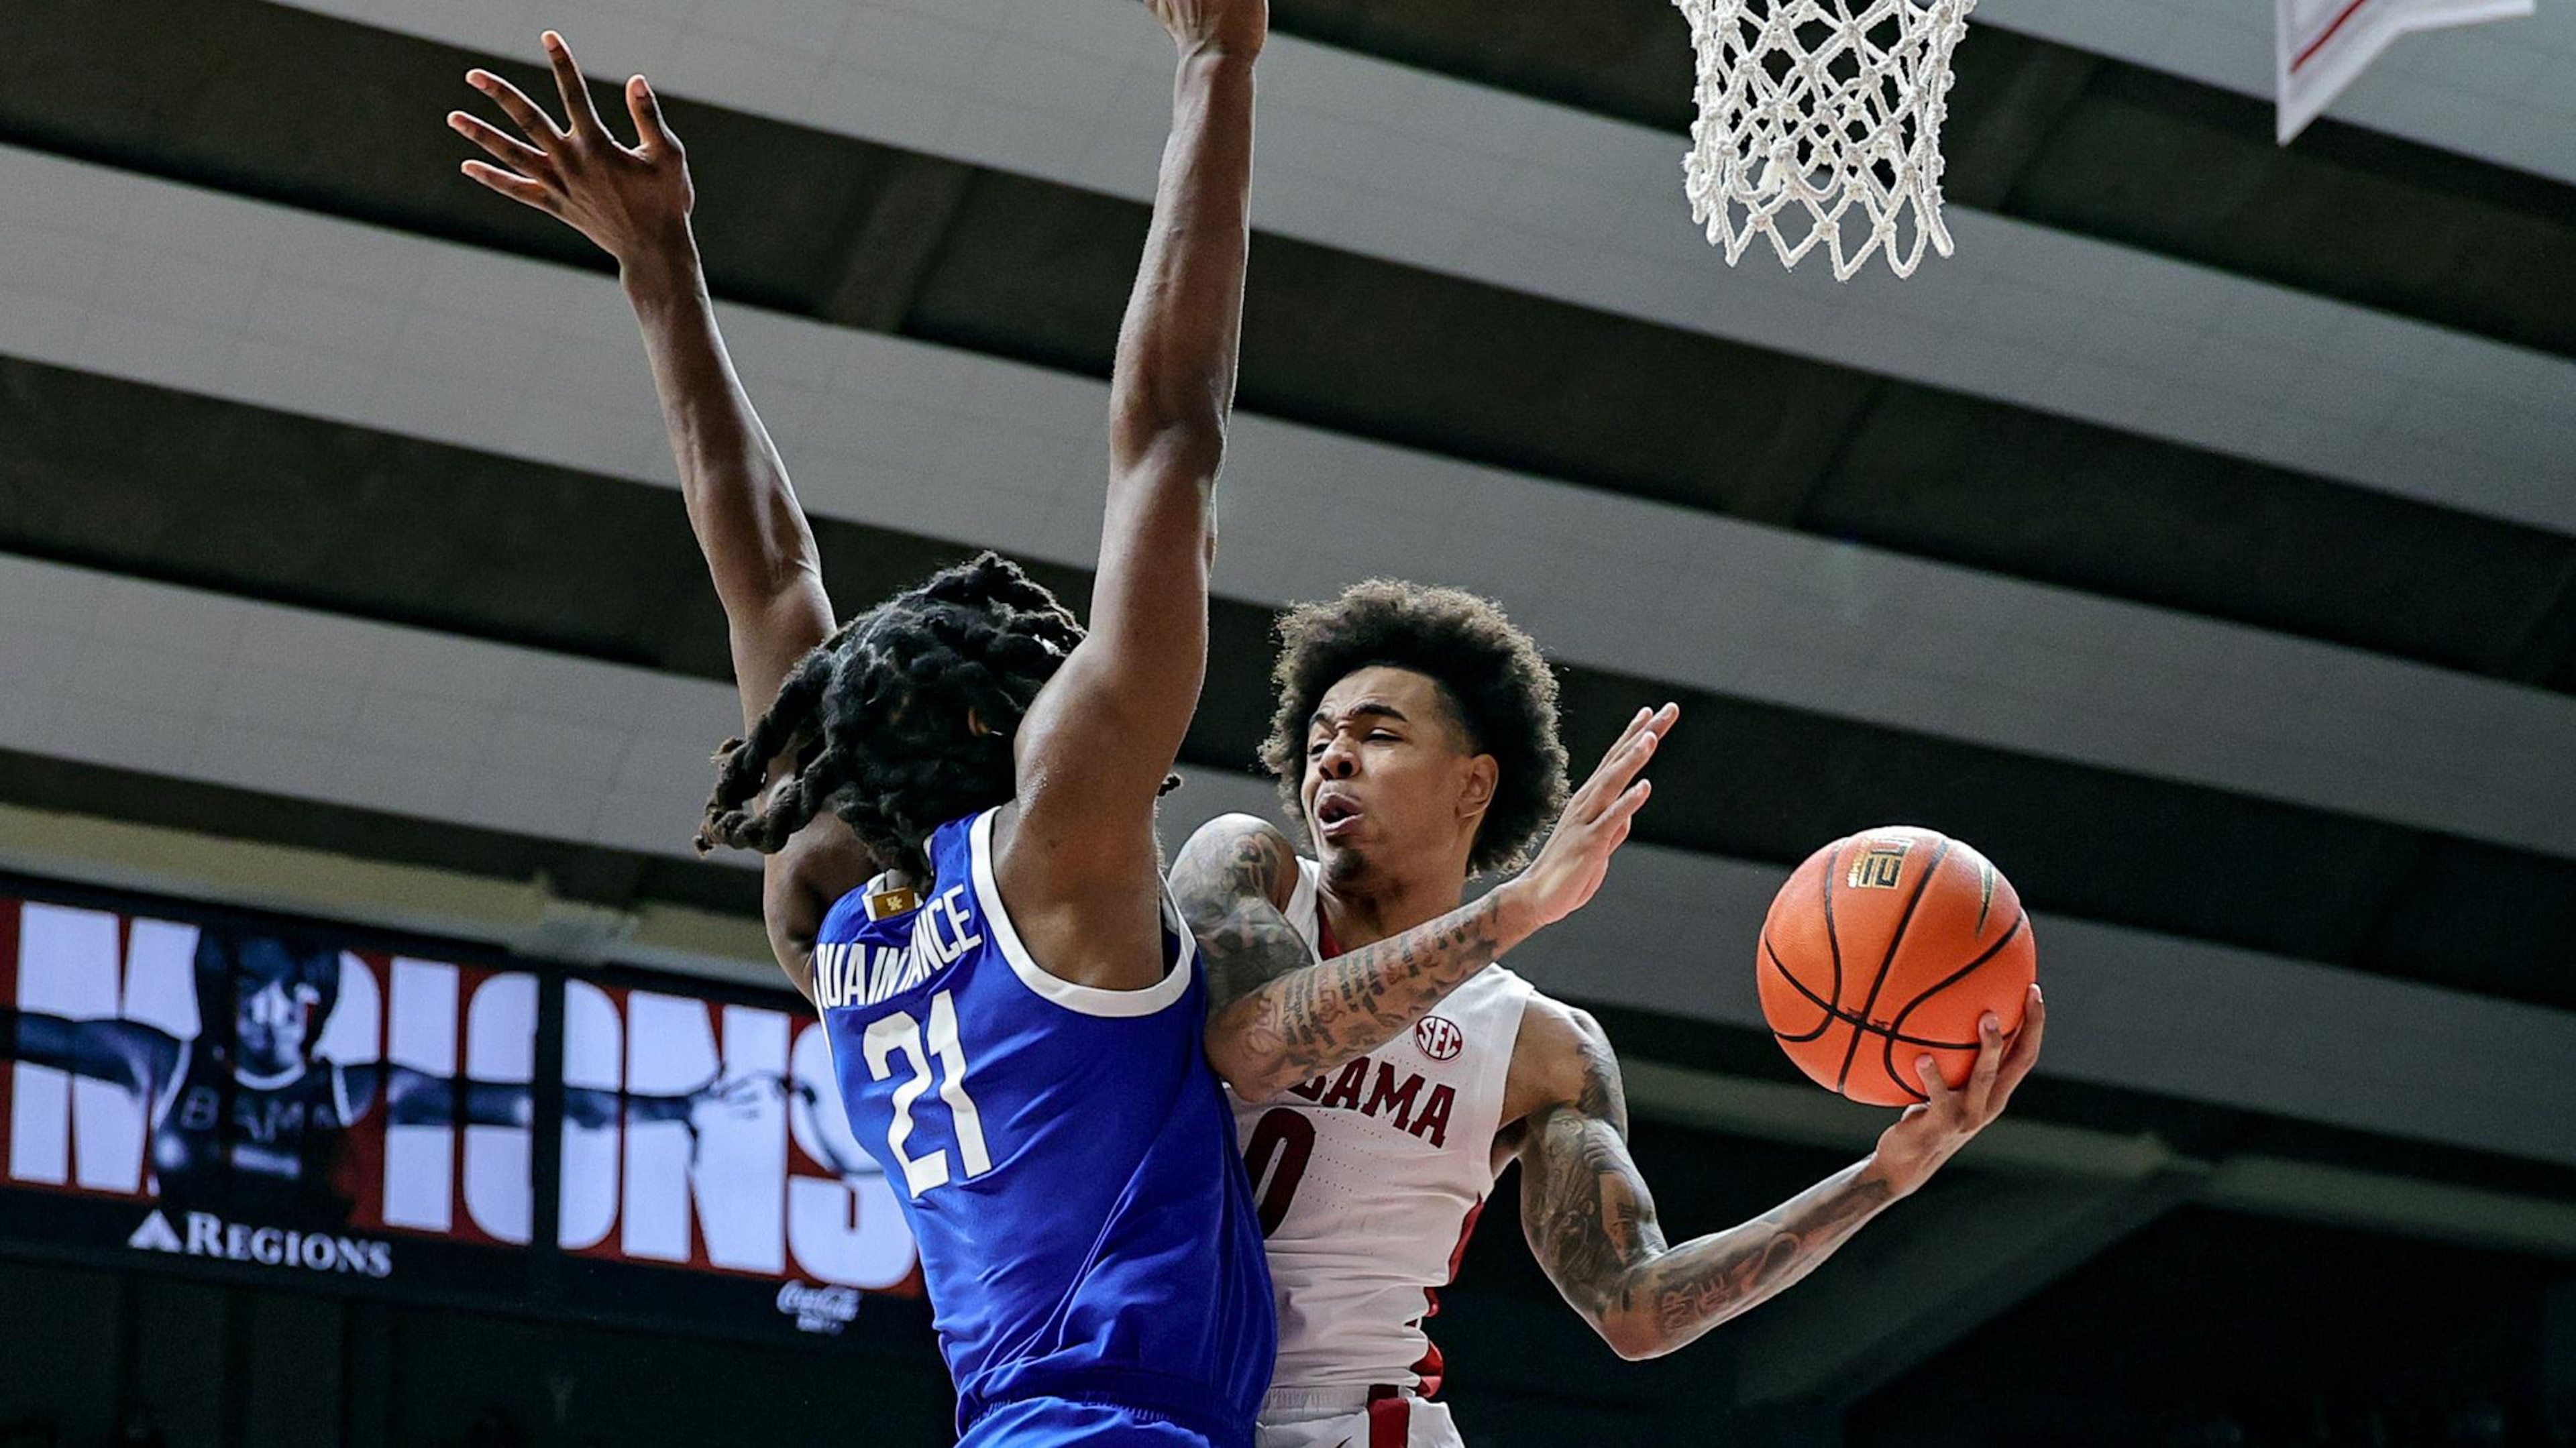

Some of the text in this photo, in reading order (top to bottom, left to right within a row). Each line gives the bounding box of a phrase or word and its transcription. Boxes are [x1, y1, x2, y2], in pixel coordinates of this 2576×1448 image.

[1417, 1017, 1460, 1059] SEC
[863, 989, 991, 1199] 21
[187, 1211, 392, 1278] REGIONS
